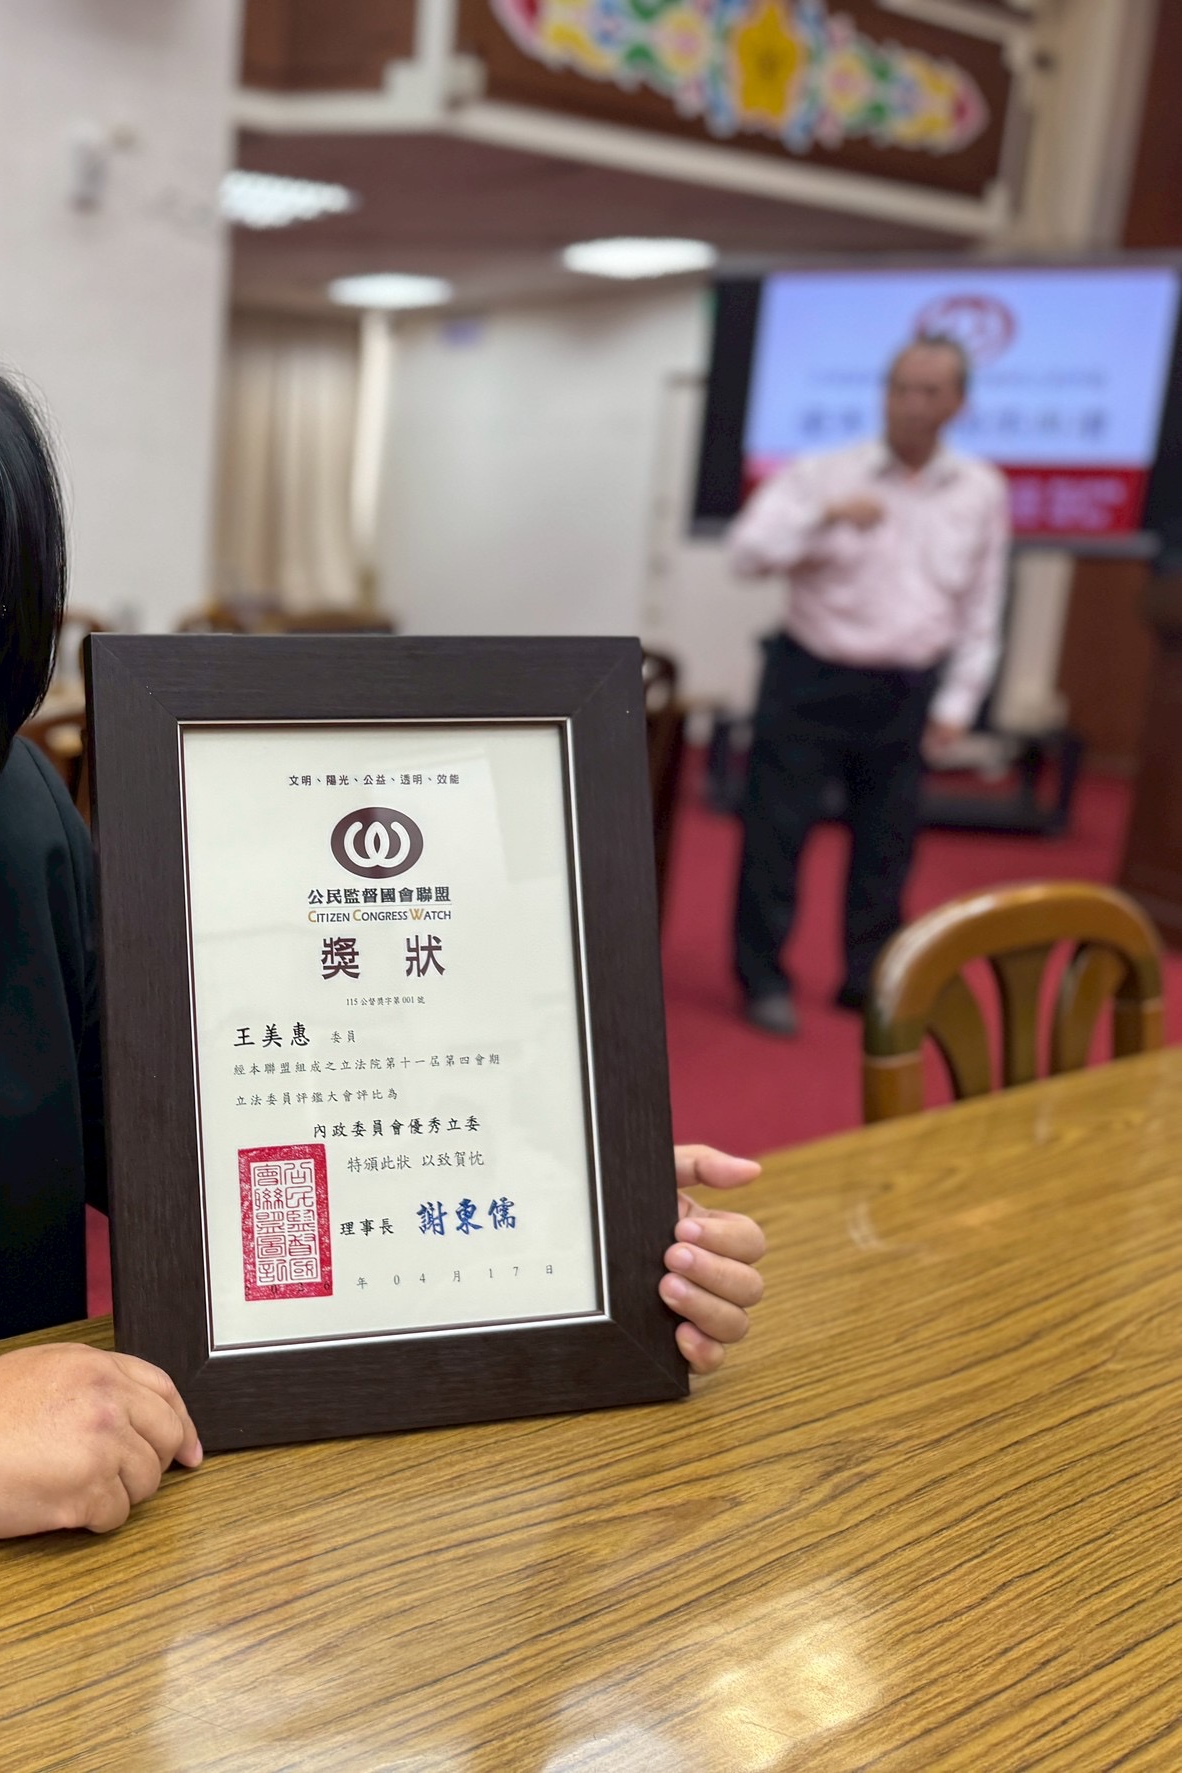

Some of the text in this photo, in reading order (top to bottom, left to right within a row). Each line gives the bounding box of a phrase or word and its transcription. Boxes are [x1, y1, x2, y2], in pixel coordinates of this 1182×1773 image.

[307, 886, 451, 905] 公民監督國會聯盟
[308, 908, 451, 923] CITIZEN CONGRESS WATCH
[233, 1021, 356, 1048] 王美惠 委員
[314, 1115, 481, 1139] 內政委員會優秀立委
[347, 1154, 412, 1173] 特頒此狀
[339, 1217, 395, 1237] 理事長
